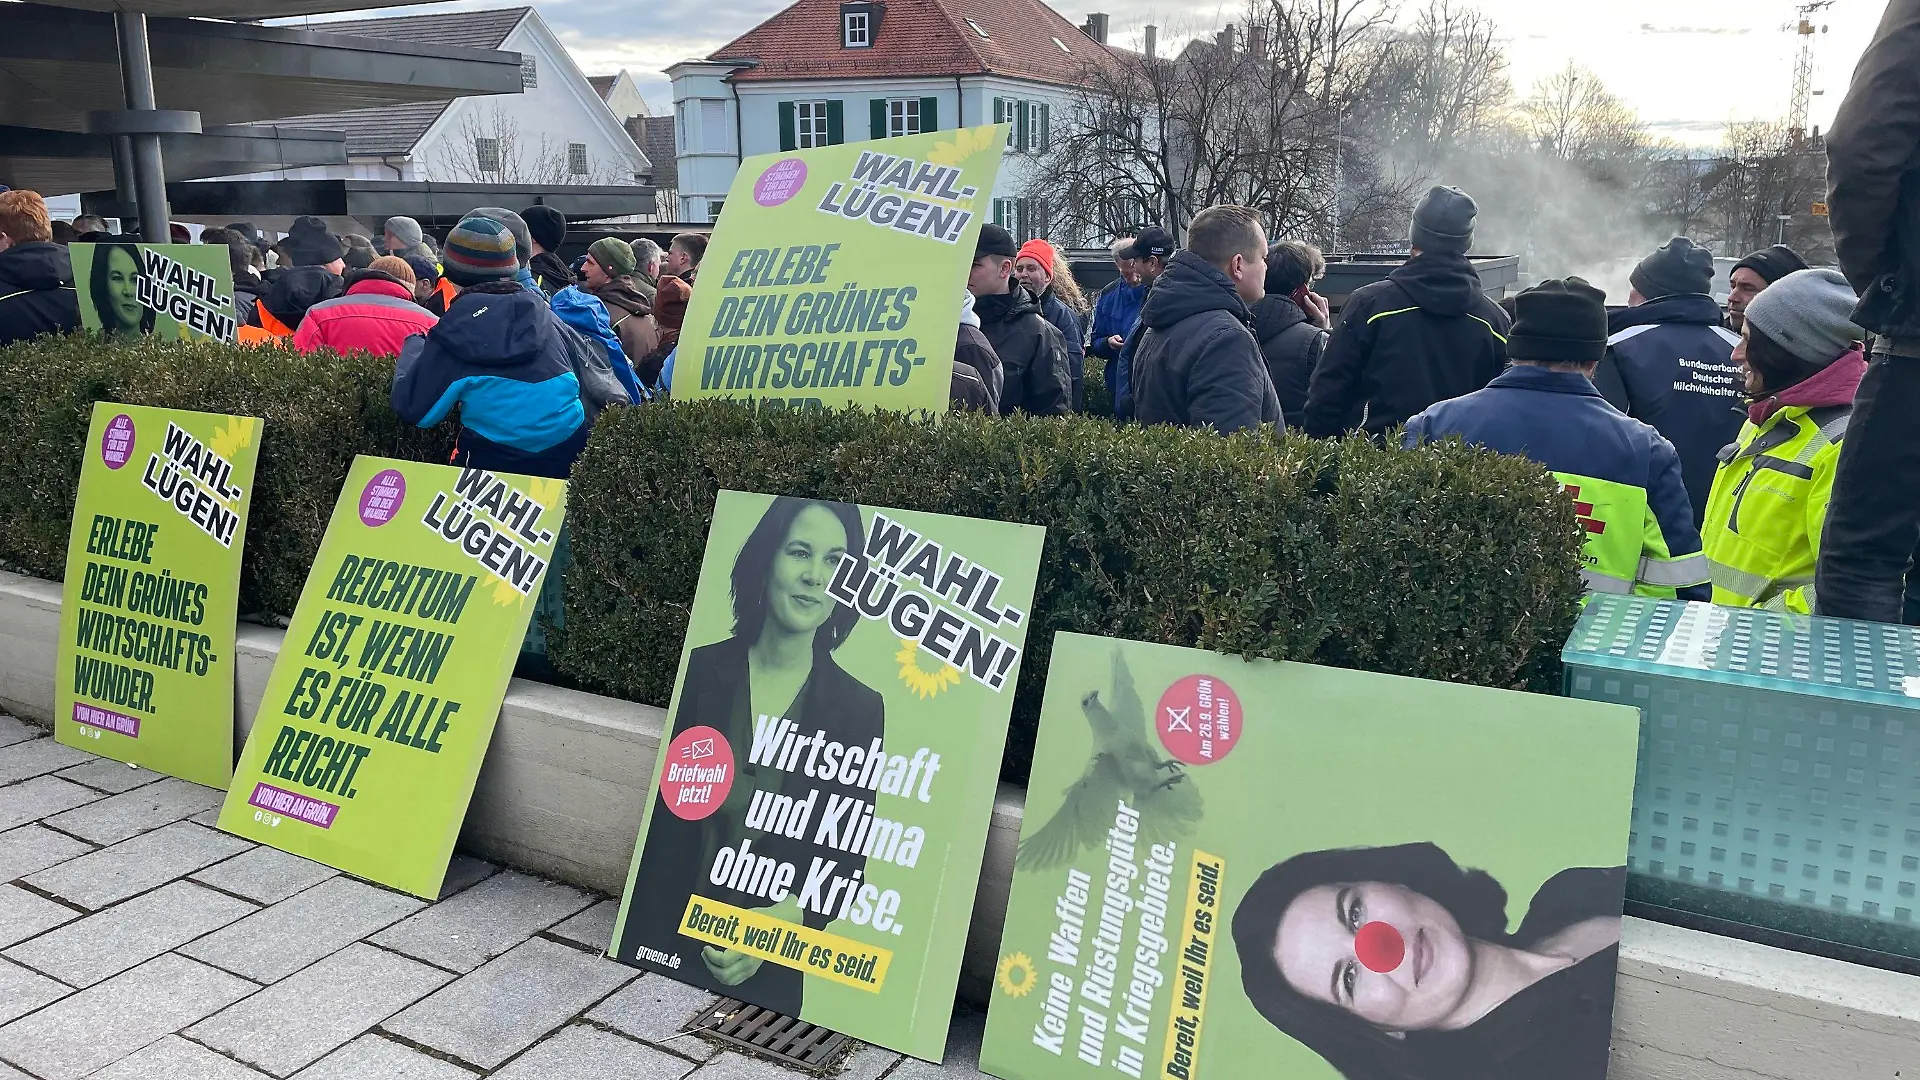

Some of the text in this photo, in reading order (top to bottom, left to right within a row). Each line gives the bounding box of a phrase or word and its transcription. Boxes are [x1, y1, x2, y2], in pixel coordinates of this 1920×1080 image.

[852, 151, 976, 199] WAHL-
[818, 183, 971, 242] LÜGEN!
[144, 249, 230, 307] WAHL-
[722, 243, 841, 288] ERLEBE
[136, 276, 234, 342] LÜGEN!
[709, 283, 918, 338] DEIN GRÜNES
[701, 338, 926, 390] WIRTSCHAFTS-
[1673, 381, 1735, 397] Milchviehhalter
[1679, 358, 1744, 373] Bundesverband
[1692, 371, 1733, 384] Deutscher
[164, 423, 240, 499] WAHL-
[381, 475, 398, 486] ALLE
[144, 456, 239, 546] LÜGEN!
[455, 468, 552, 543] WAHL-
[86, 515, 158, 565] ERLEBE
[424, 493, 545, 593] LÜGEN!
[864, 515, 1022, 627] WAHL-
[81, 562, 208, 626] DEIN GRÜNES
[326, 554, 477, 624] REICHTUM
[826, 555, 1018, 690] LÜGEN!
[77, 608, 217, 676] WIRTSCHAFTS-
[304, 610, 454, 684] IST, WENN
[74, 655, 156, 714] WUNDER.
[76, 705, 90, 722] VON
[105, 713, 116, 729] AN
[284, 667, 461, 754] ES FÜR ALLE
[1197, 679, 1212, 758] Am 26.9. GRÜN
[1216, 698, 1230, 740] wählen!
[263, 725, 371, 799] REICHT.
[668, 762, 727, 784] Briefwahl
[748, 713, 941, 803] Wirtschaft
[255, 786, 276, 806] VON
[272, 792, 294, 813] HIER
[290, 798, 307, 817] AN
[676, 784, 711, 806] jetzt!
[744, 788, 925, 869] und Klima
[709, 839, 904, 936] ohne Krise.
[635, 945, 681, 970] gruene.de
[686, 903, 879, 984] Bereit, weil Ihr es seid.
[1032, 868, 1091, 1056] Keine Waffen
[1077, 799, 1140, 1067] und Rüstungsgüter
[1111, 841, 1177, 1079] in Kriegsgebiete.
[1167, 862, 1220, 1080] Bereit, weil Ihr es seid.
